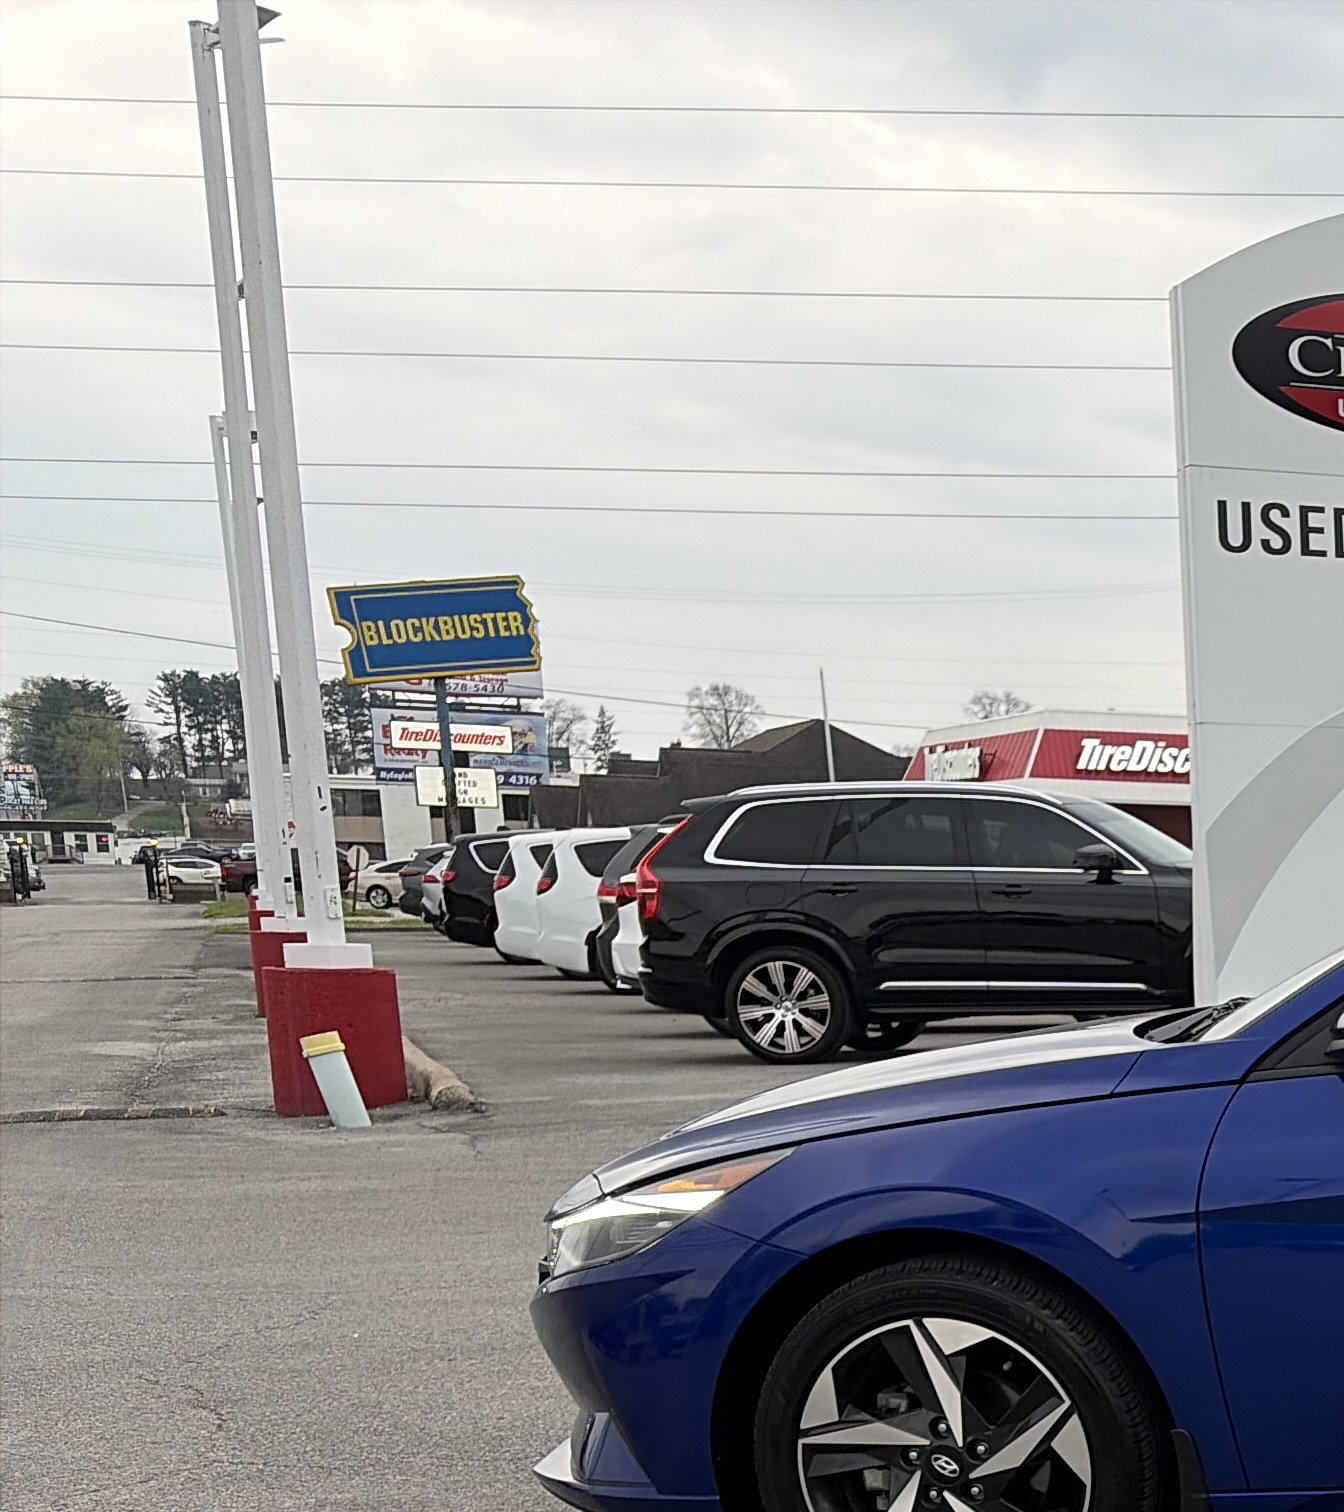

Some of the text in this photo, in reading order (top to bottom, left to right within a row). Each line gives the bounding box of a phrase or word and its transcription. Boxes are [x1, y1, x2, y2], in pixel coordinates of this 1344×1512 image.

[360, 610, 526, 647] BLOCKBUSTER
[398, 727, 507, 746] TireDiounters
[508, 774, 538, 786] 4316
